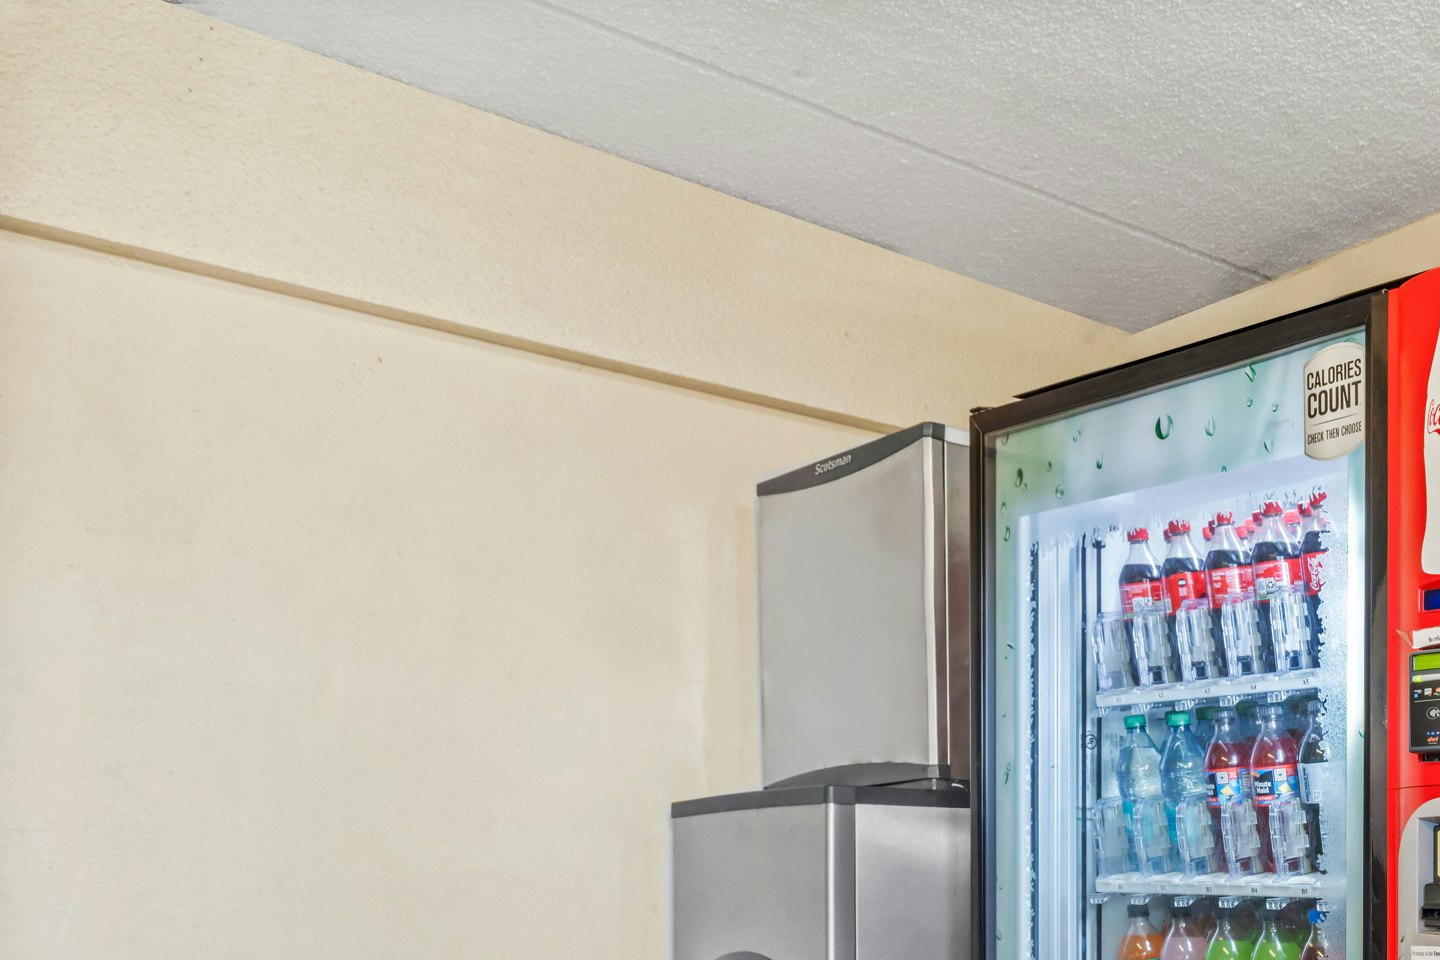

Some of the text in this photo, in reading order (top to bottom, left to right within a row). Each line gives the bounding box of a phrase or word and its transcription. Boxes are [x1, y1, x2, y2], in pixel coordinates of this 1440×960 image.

[1307, 358, 1362, 391] CALORIES
[1307, 380, 1362, 419] COUNT
[1307, 421, 1362, 445] CHECK THEN CHOOSE
[814, 454, 852, 475] Scotsman
